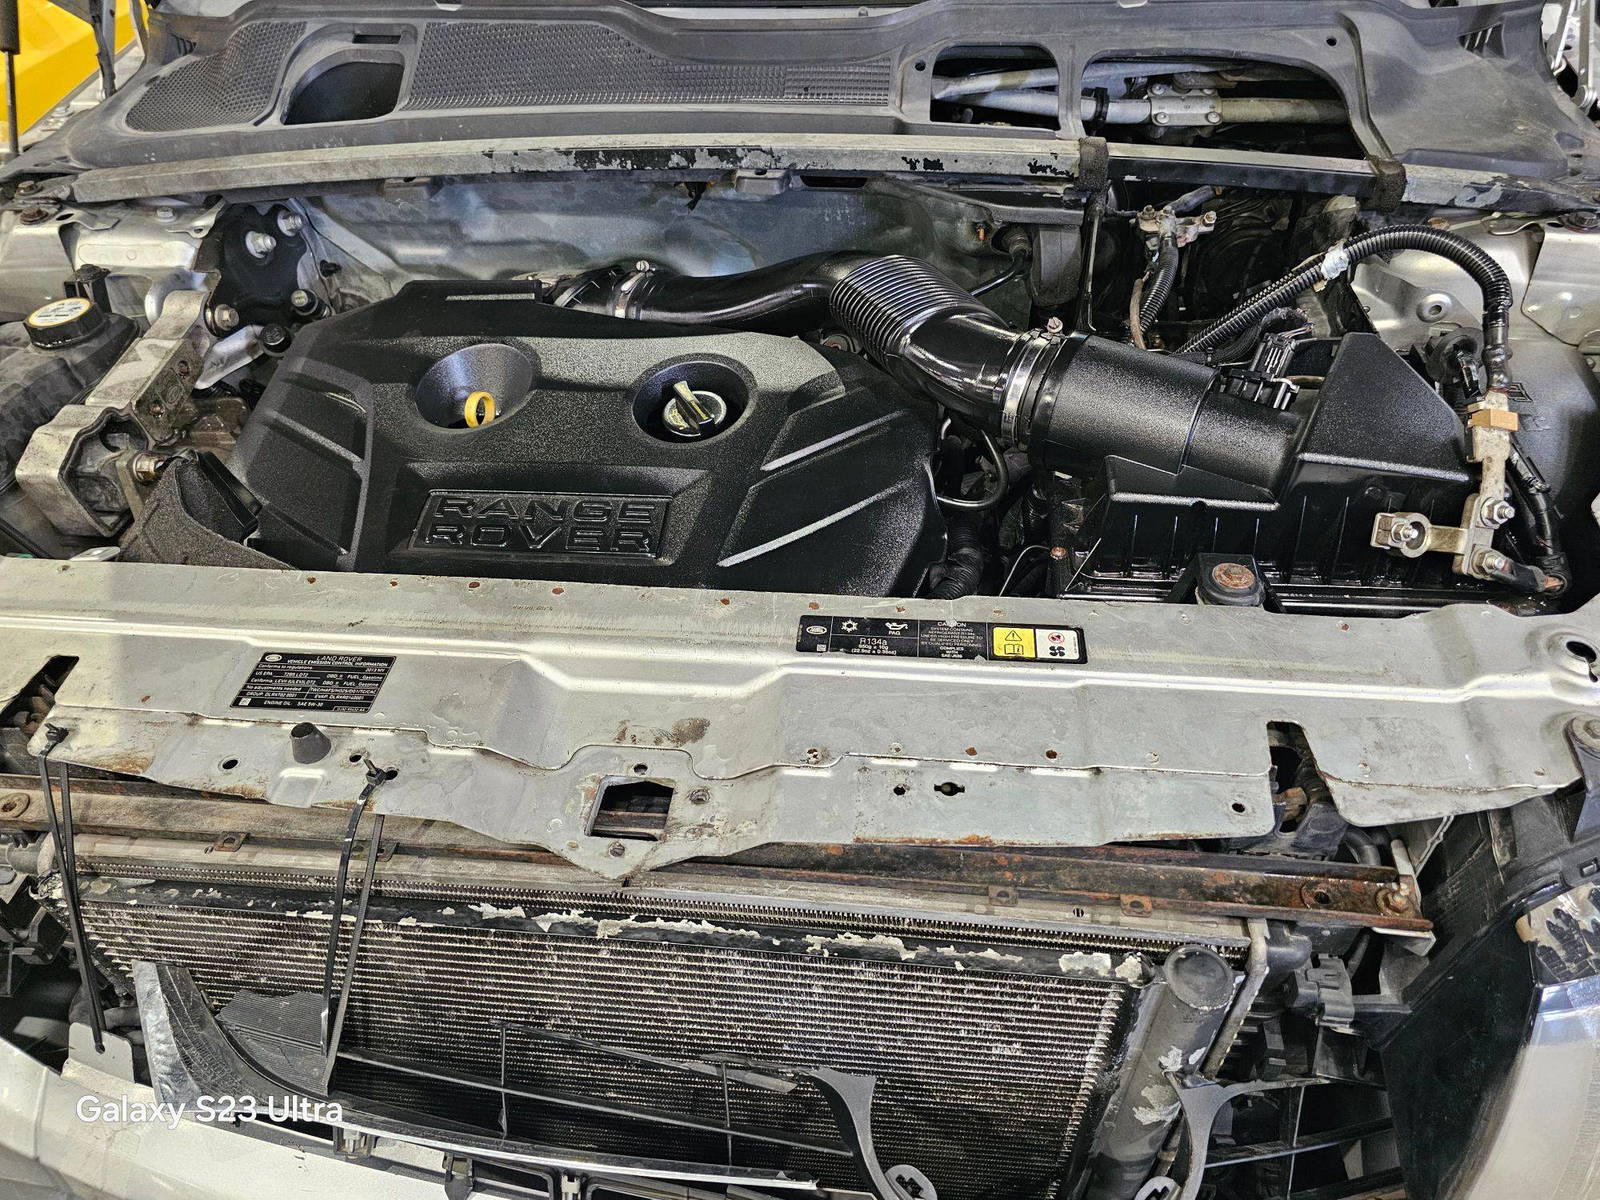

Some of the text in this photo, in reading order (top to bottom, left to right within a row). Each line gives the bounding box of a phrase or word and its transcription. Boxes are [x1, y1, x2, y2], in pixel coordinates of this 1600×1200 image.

[433, 498, 655, 523] RANGE
[425, 524, 652, 552] ROVER
[859, 637, 888, 646] R134a
